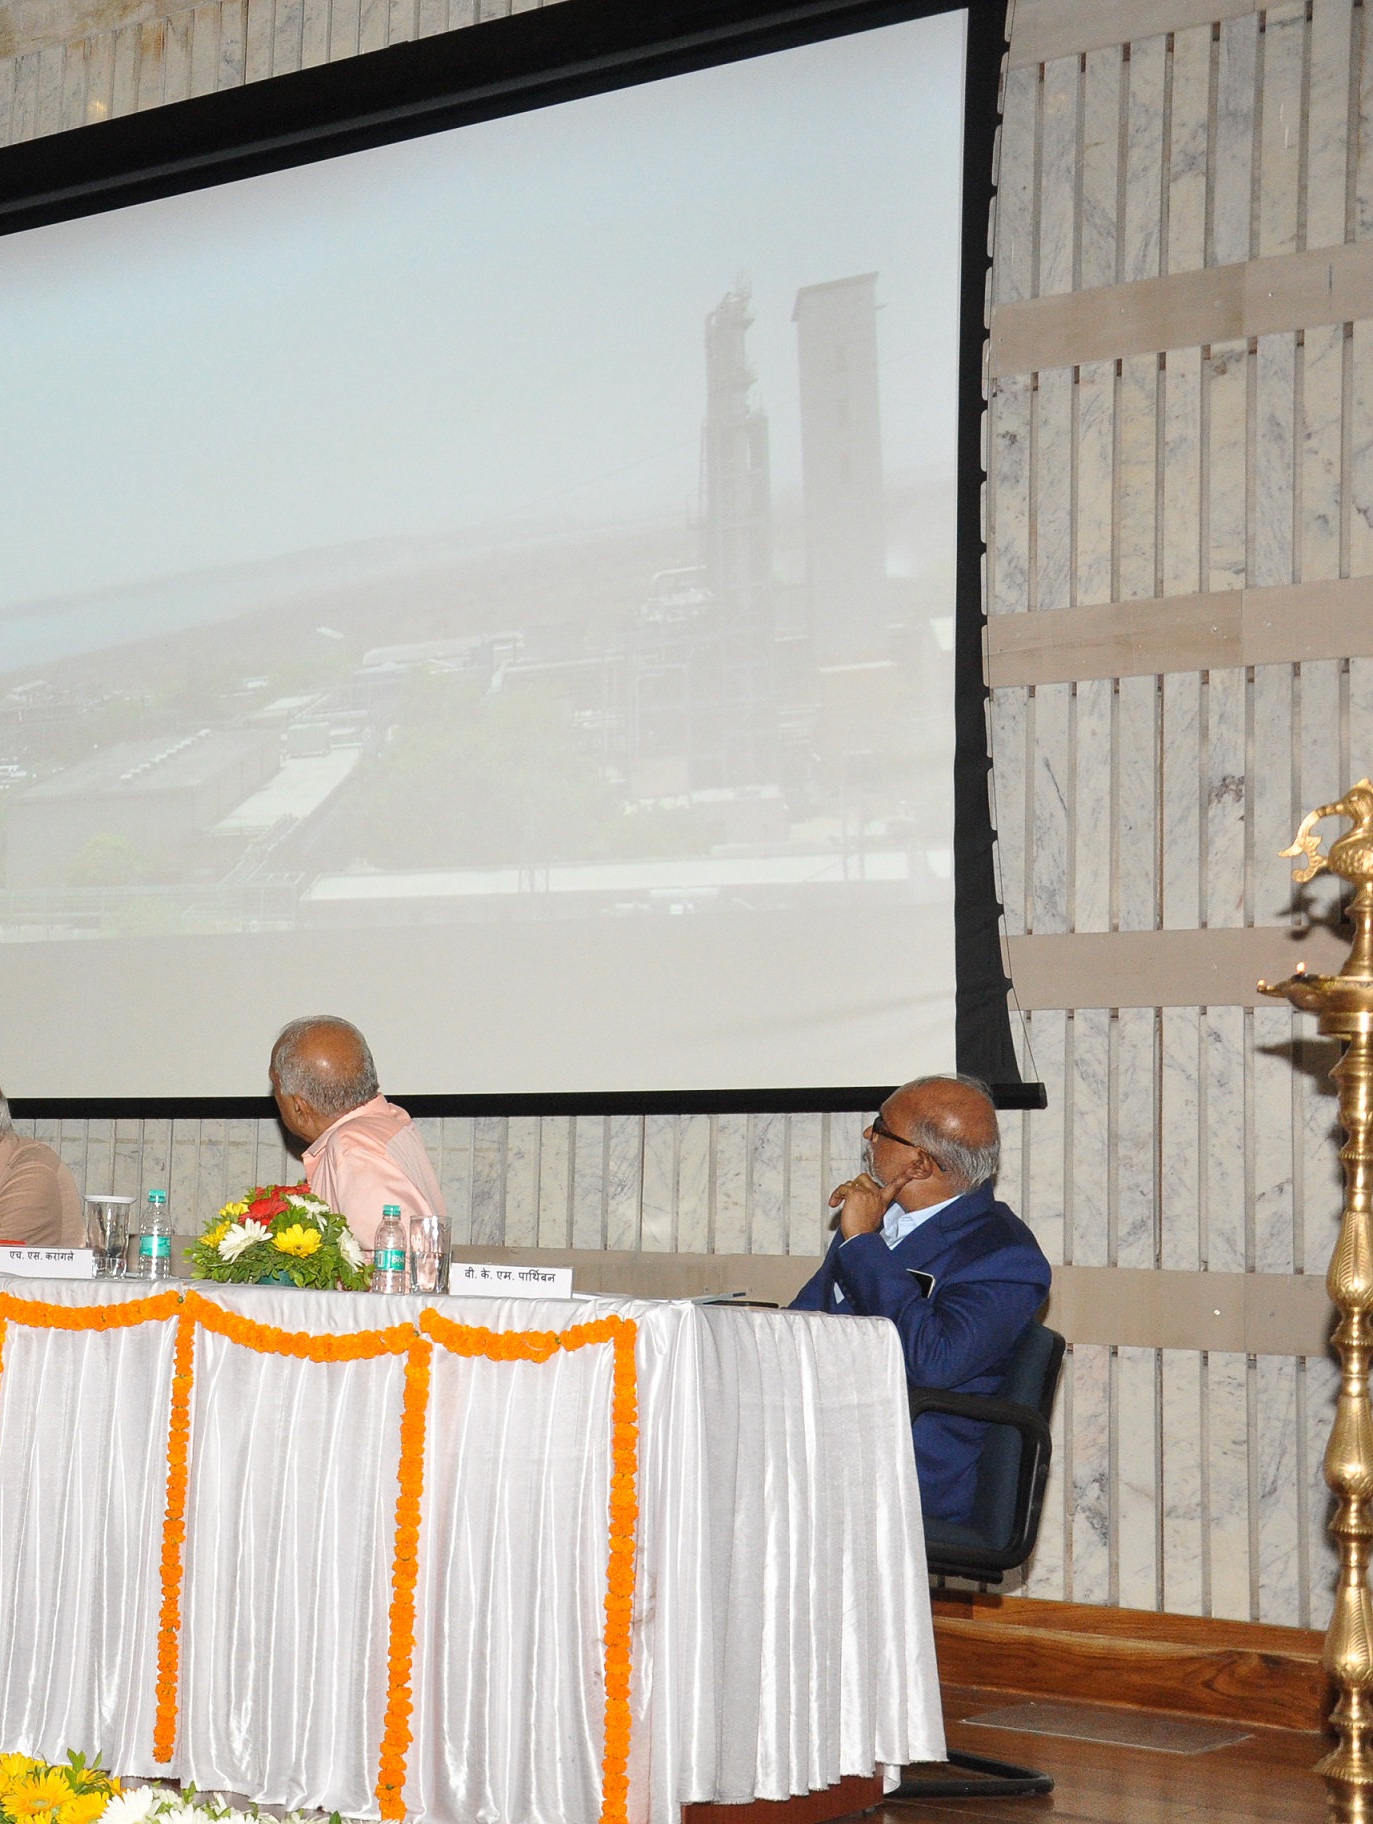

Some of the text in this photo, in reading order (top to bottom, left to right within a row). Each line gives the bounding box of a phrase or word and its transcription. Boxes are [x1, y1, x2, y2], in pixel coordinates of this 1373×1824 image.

[9, 1250, 25, 1260] एच.
[27, 1251, 43, 1261] एस.
[464, 1267, 477, 1279] वी.
[480, 1267, 493, 1280] के.
[496, 1270, 515, 1281] एम.
